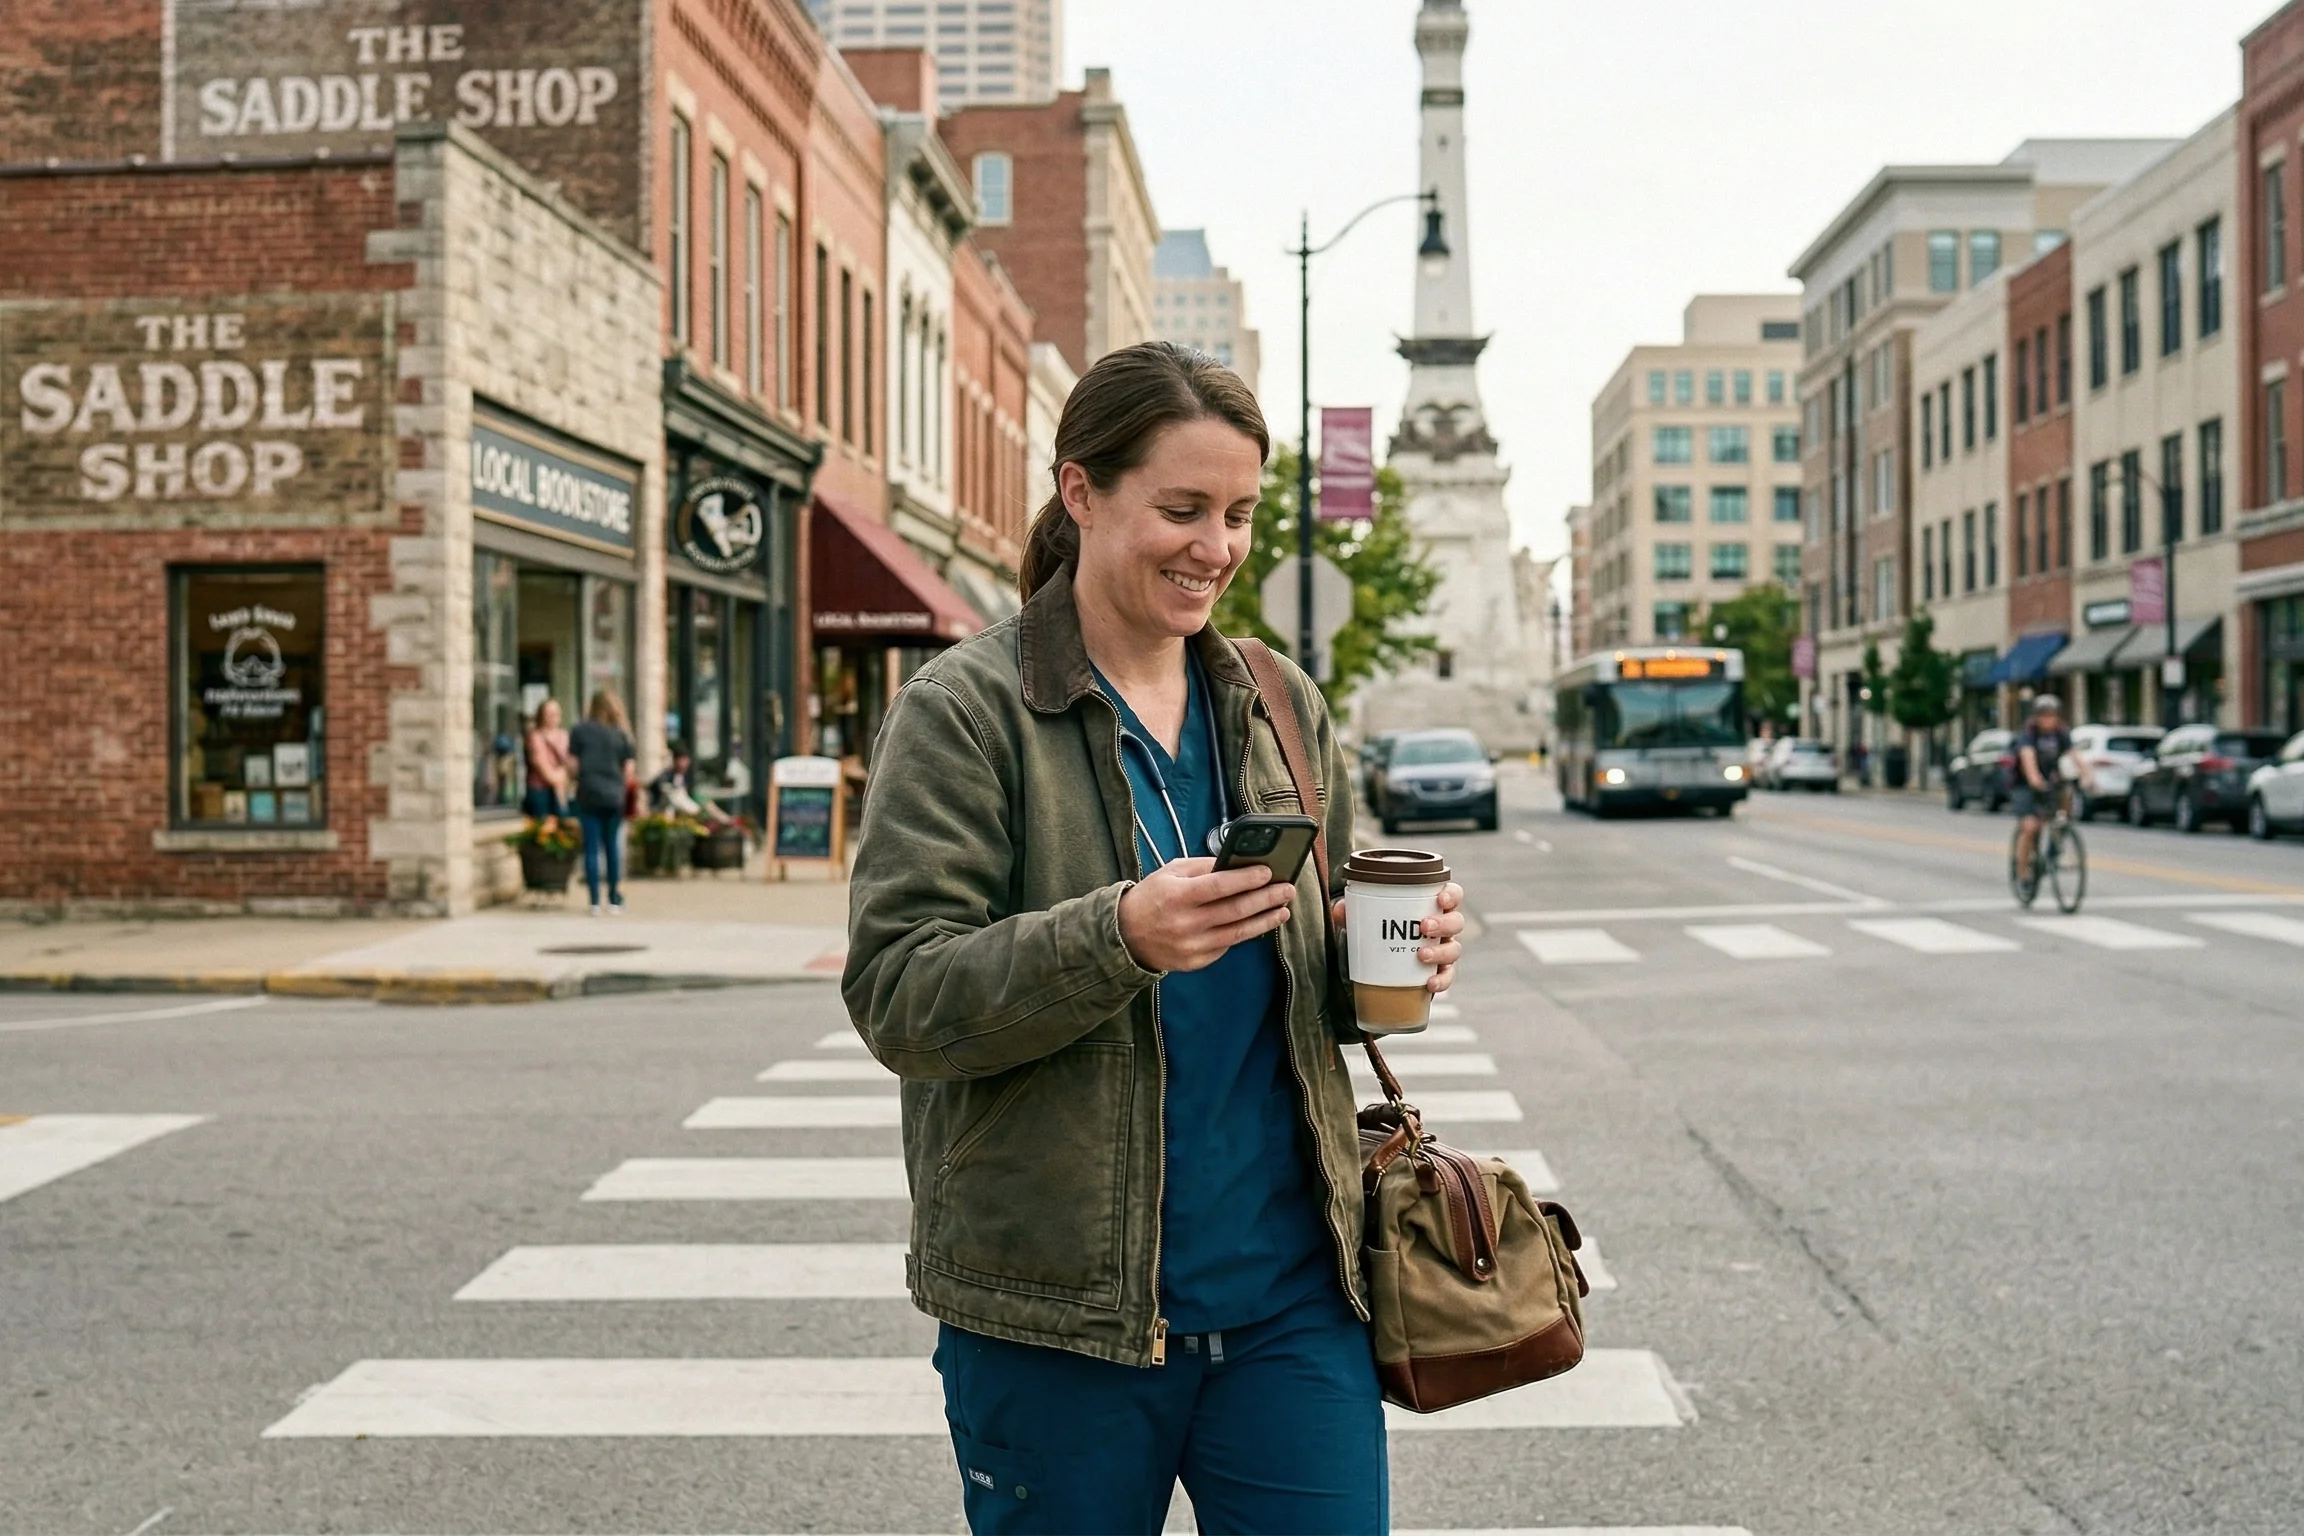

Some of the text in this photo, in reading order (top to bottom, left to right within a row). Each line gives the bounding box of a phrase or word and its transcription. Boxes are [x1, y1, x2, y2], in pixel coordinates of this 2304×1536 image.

[347, 24, 466, 65] THE
[201, 66, 619, 137] SADDLE SHOP
[135, 313, 247, 351] THE
[19, 359, 364, 433] SADDLE
[79, 441, 304, 501] SHOP
[473, 440, 535, 505] LOCAL
[1382, 919, 1437, 941] IND
